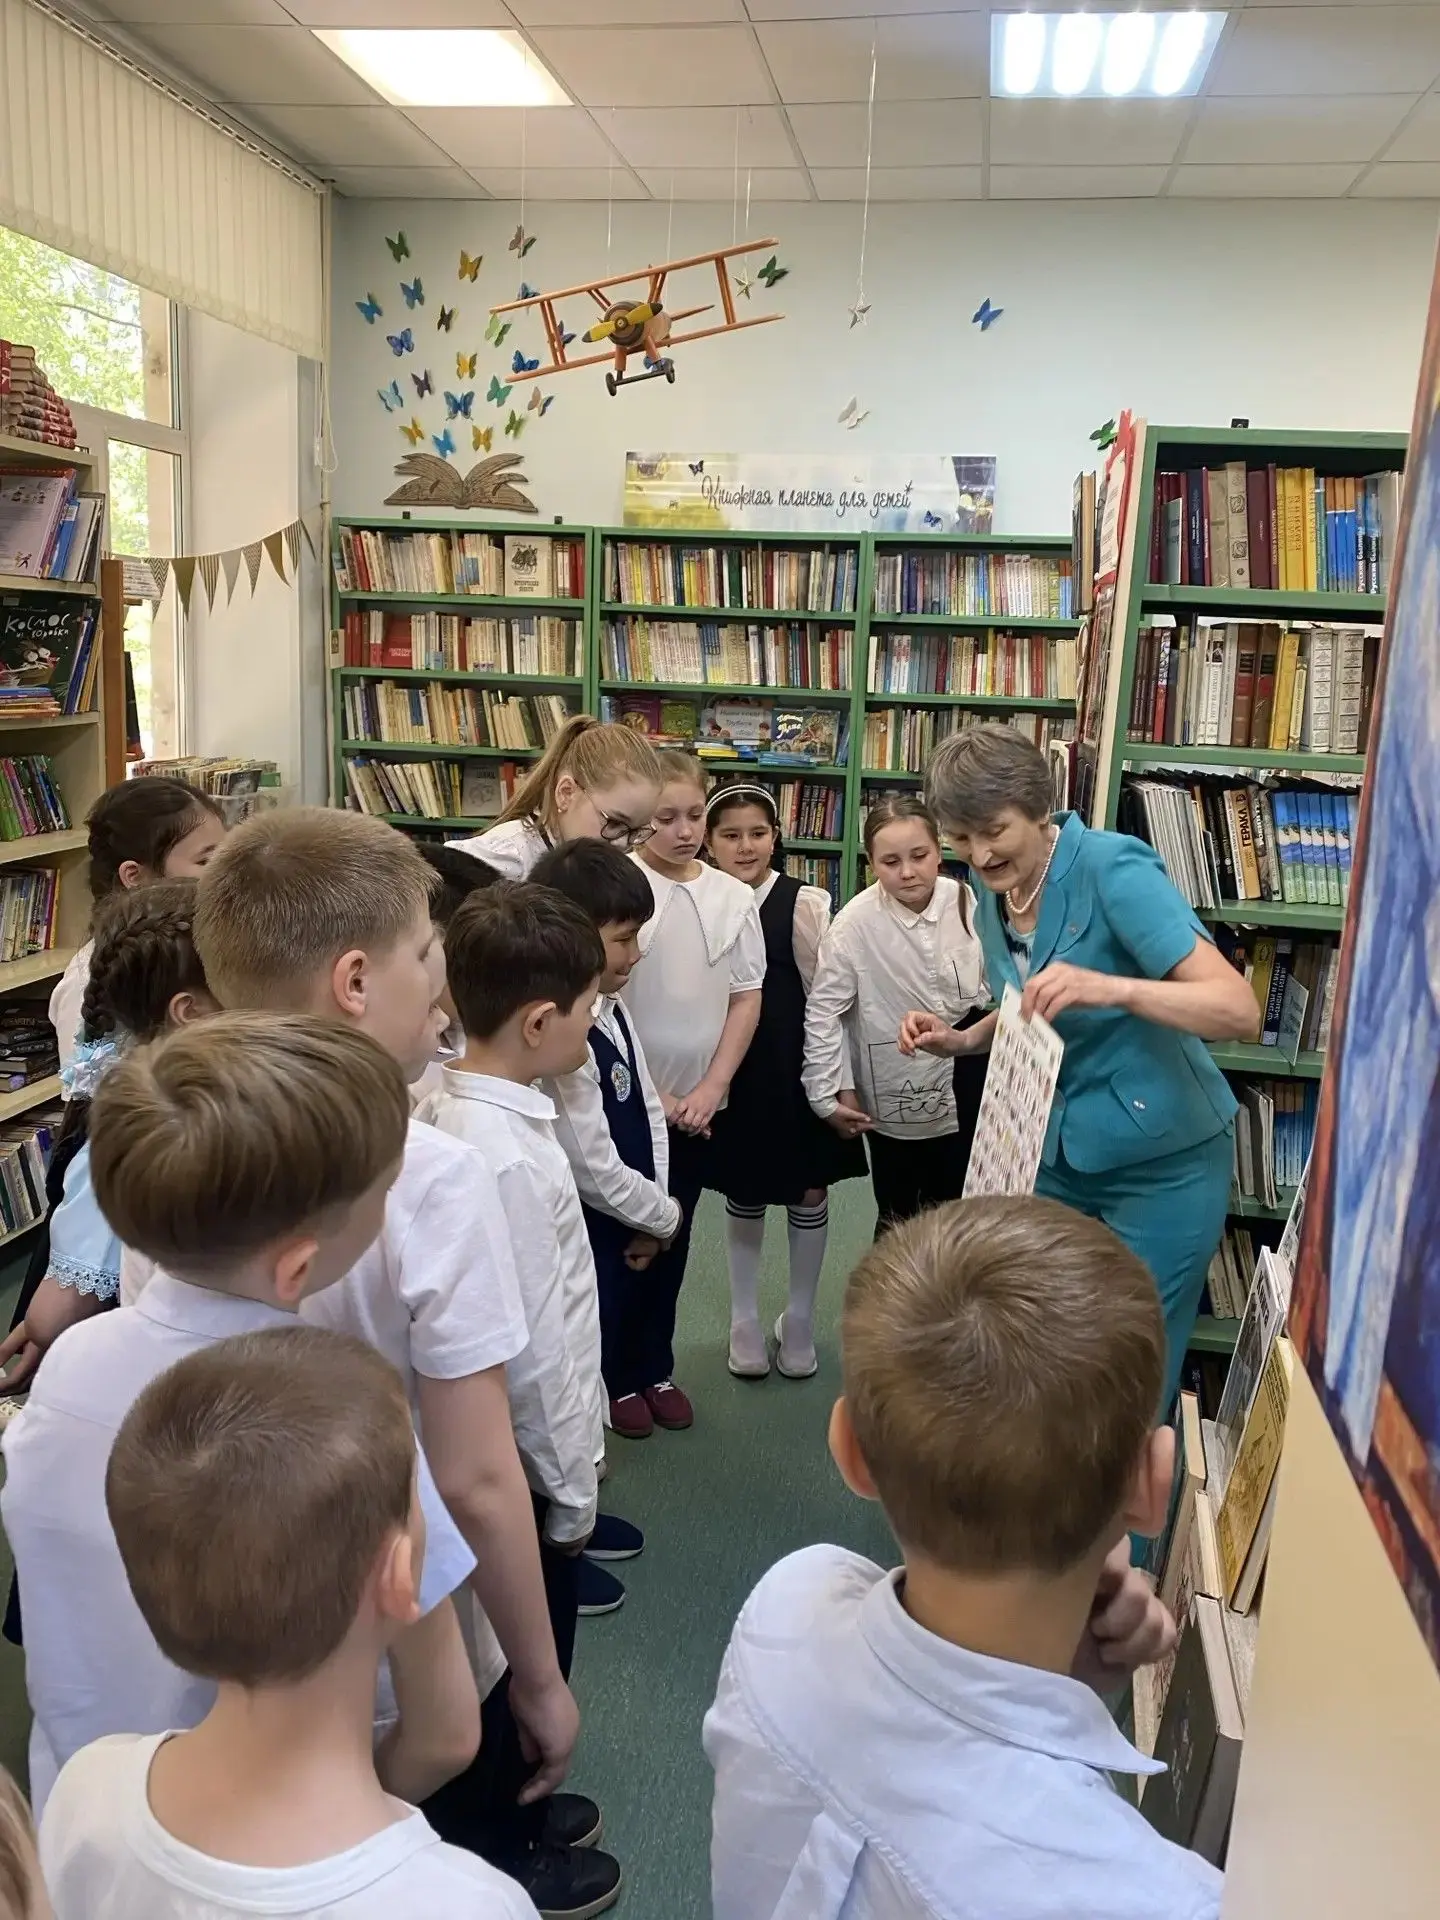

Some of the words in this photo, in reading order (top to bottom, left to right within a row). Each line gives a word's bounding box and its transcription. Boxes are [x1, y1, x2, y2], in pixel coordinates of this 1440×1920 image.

[701, 475, 772, 511] Книжная
[778, 488, 834, 507] планета
[836, 490, 868, 517] для
[870, 480, 914, 518] детей
[1238, 807, 1252, 847] ГЕРАКЛ
